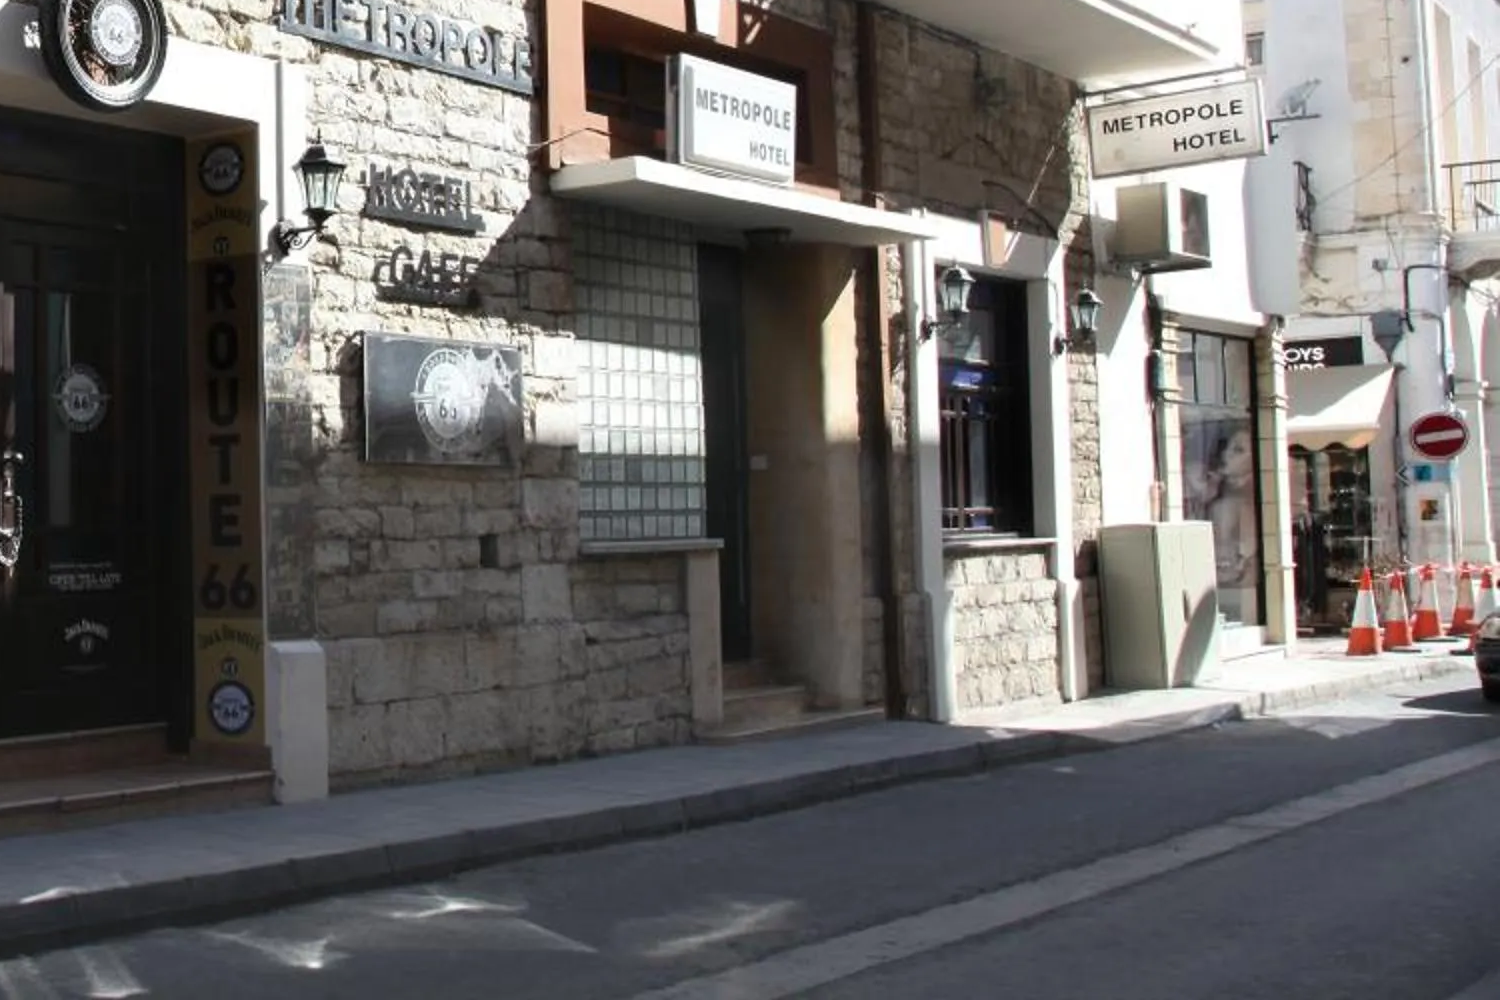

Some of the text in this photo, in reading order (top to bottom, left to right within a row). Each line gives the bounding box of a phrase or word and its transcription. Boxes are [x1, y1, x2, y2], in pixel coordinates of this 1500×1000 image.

[695, 87, 792, 132] METROPOLE
[1102, 99, 1245, 135] METROPOLE
[748, 140, 792, 167] HOTEL
[1172, 128, 1246, 153] HOTEL
[368, 163, 486, 231] HOTEL
[205, 263, 242, 548] ROUTE
[200, 563, 256, 611] 66
